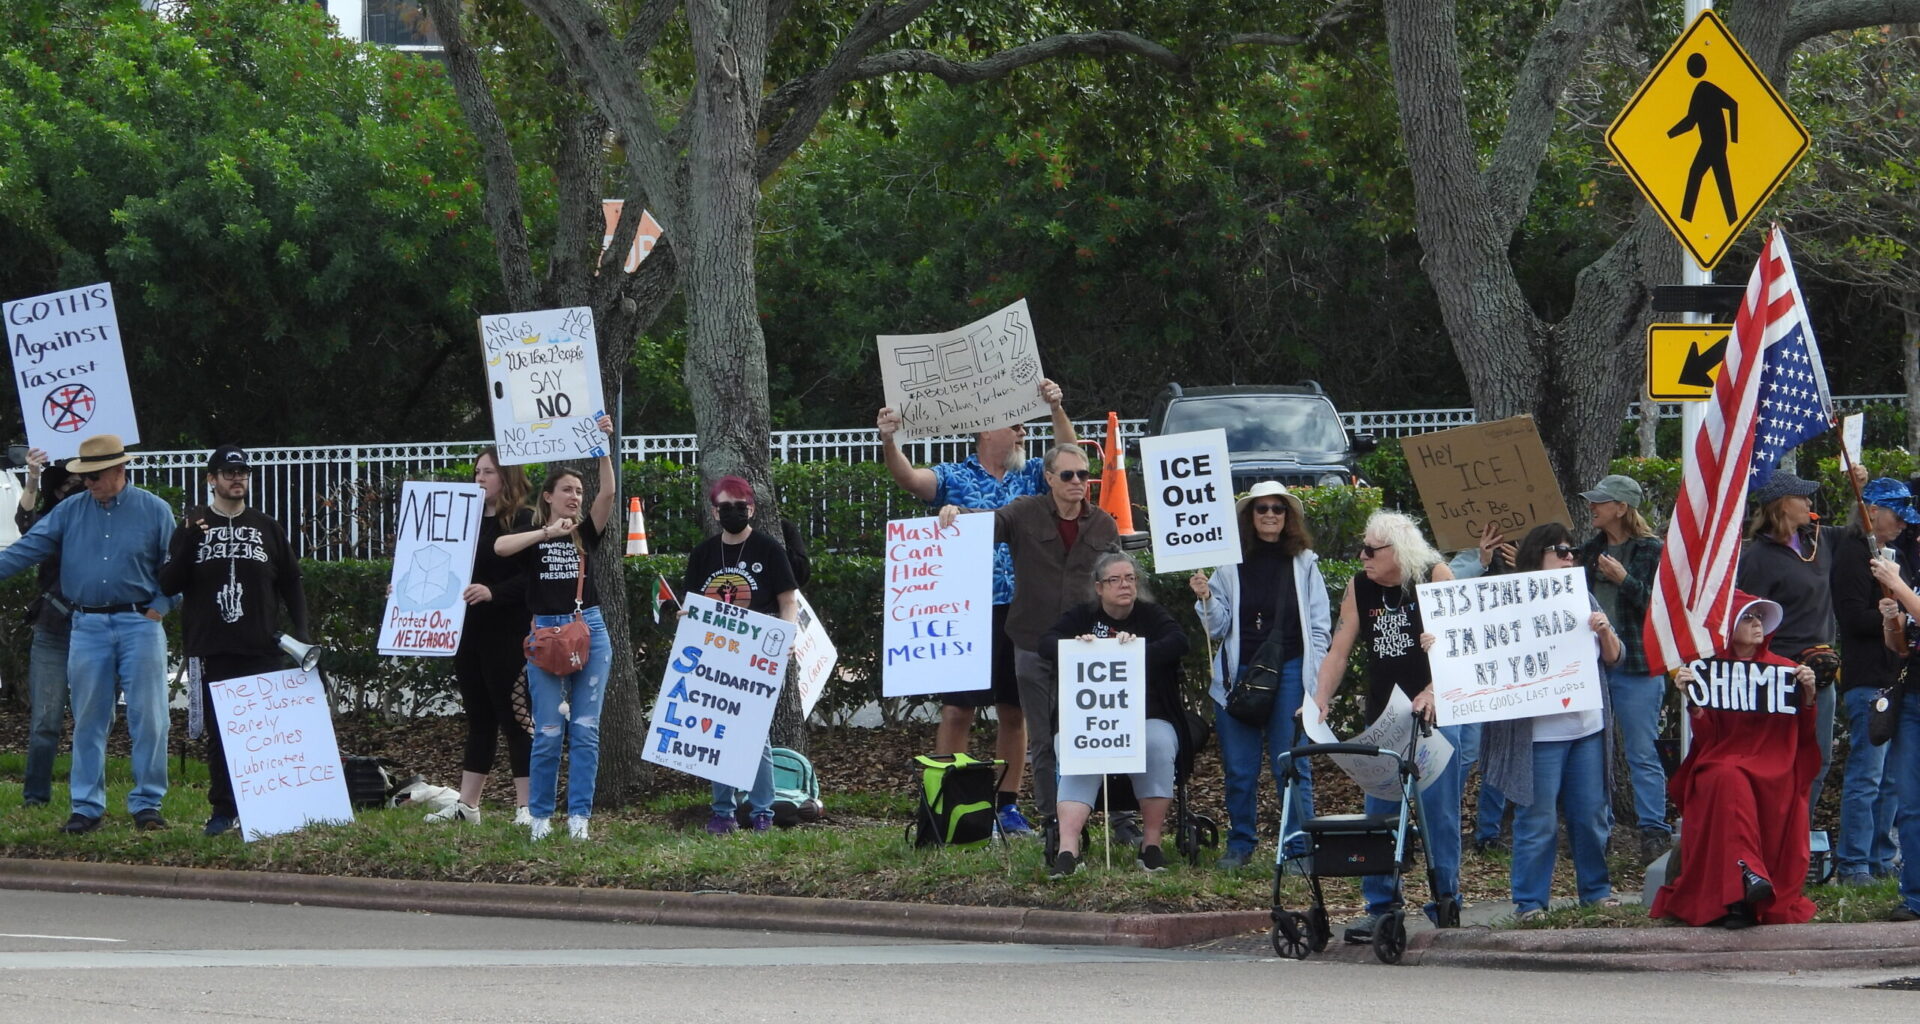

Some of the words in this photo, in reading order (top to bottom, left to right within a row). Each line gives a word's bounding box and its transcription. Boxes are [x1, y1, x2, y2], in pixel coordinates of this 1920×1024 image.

[486, 317, 510, 336] NO
[559, 317, 591, 340] ICE
[567, 309, 591, 328] NO
[15, 326, 111, 364] Against
[486, 321, 532, 353] KINGS
[505, 351, 529, 372] We
[548, 344, 584, 364] People
[21, 361, 98, 388] Fascist
[530, 369, 562, 394] SAY
[536, 392, 571, 418] NO
[504, 427, 526, 443] NO
[572, 417, 594, 438] NO
[499, 438, 566, 459] FASCISTS
[1160, 454, 1212, 481] ICE
[1162, 482, 1216, 507] Out
[399, 489, 477, 542] MELT
[1487, 500, 1510, 516] Be
[1175, 512, 1209, 528] For
[199, 526, 263, 546] FUCK
[1166, 527, 1223, 546] Good!
[195, 542, 269, 564] NAZIS
[541, 555, 581, 564] CRIMINALS
[548, 548, 562, 556] ARE
[562, 547, 578, 557] NOT
[890, 544, 943, 562] Can't
[549, 563, 564, 571] BUT
[564, 562, 579, 570] THE
[892, 562, 944, 583] Hide
[1475, 579, 1523, 612] FINE
[1528, 574, 1574, 602] DUDE
[390, 606, 427, 629] Protect
[715, 601, 749, 619] BEST
[892, 600, 971, 622] Crimes!
[687, 605, 762, 640] REMEDY
[909, 620, 961, 640] ICE
[1373, 622, 1387, 631] NO
[1381, 627, 1400, 637] YOU
[1484, 619, 1521, 650] NOT
[1532, 609, 1577, 638] MAD
[393, 629, 458, 649] NEIGHBORS
[1373, 639, 1415, 652] ORANGE
[1374, 633, 1410, 644] STUPID
[704, 631, 740, 654] FOR
[750, 654, 779, 676] ICE
[672, 645, 777, 699] SOLIDARITY
[1077, 661, 1127, 683] ICE
[212, 683, 254, 701] The
[257, 673, 308, 696] Dildo
[667, 676, 741, 716] ACTION
[1687, 659, 1797, 714] SHAME
[233, 699, 258, 716] of
[262, 695, 316, 711] Justice
[1075, 688, 1129, 710] Out
[1452, 703, 1485, 719] RENEE
[1526, 687, 1549, 701] LAST
[1554, 681, 1585, 695] WORDS
[227, 714, 279, 736] Rarely
[1086, 716, 1120, 731] For
[245, 729, 303, 752] Comes
[656, 727, 721, 766] TRUTH
[1074, 734, 1130, 749] Good!
[234, 752, 304, 779] Lubricated
[293, 765, 336, 787] ICE
